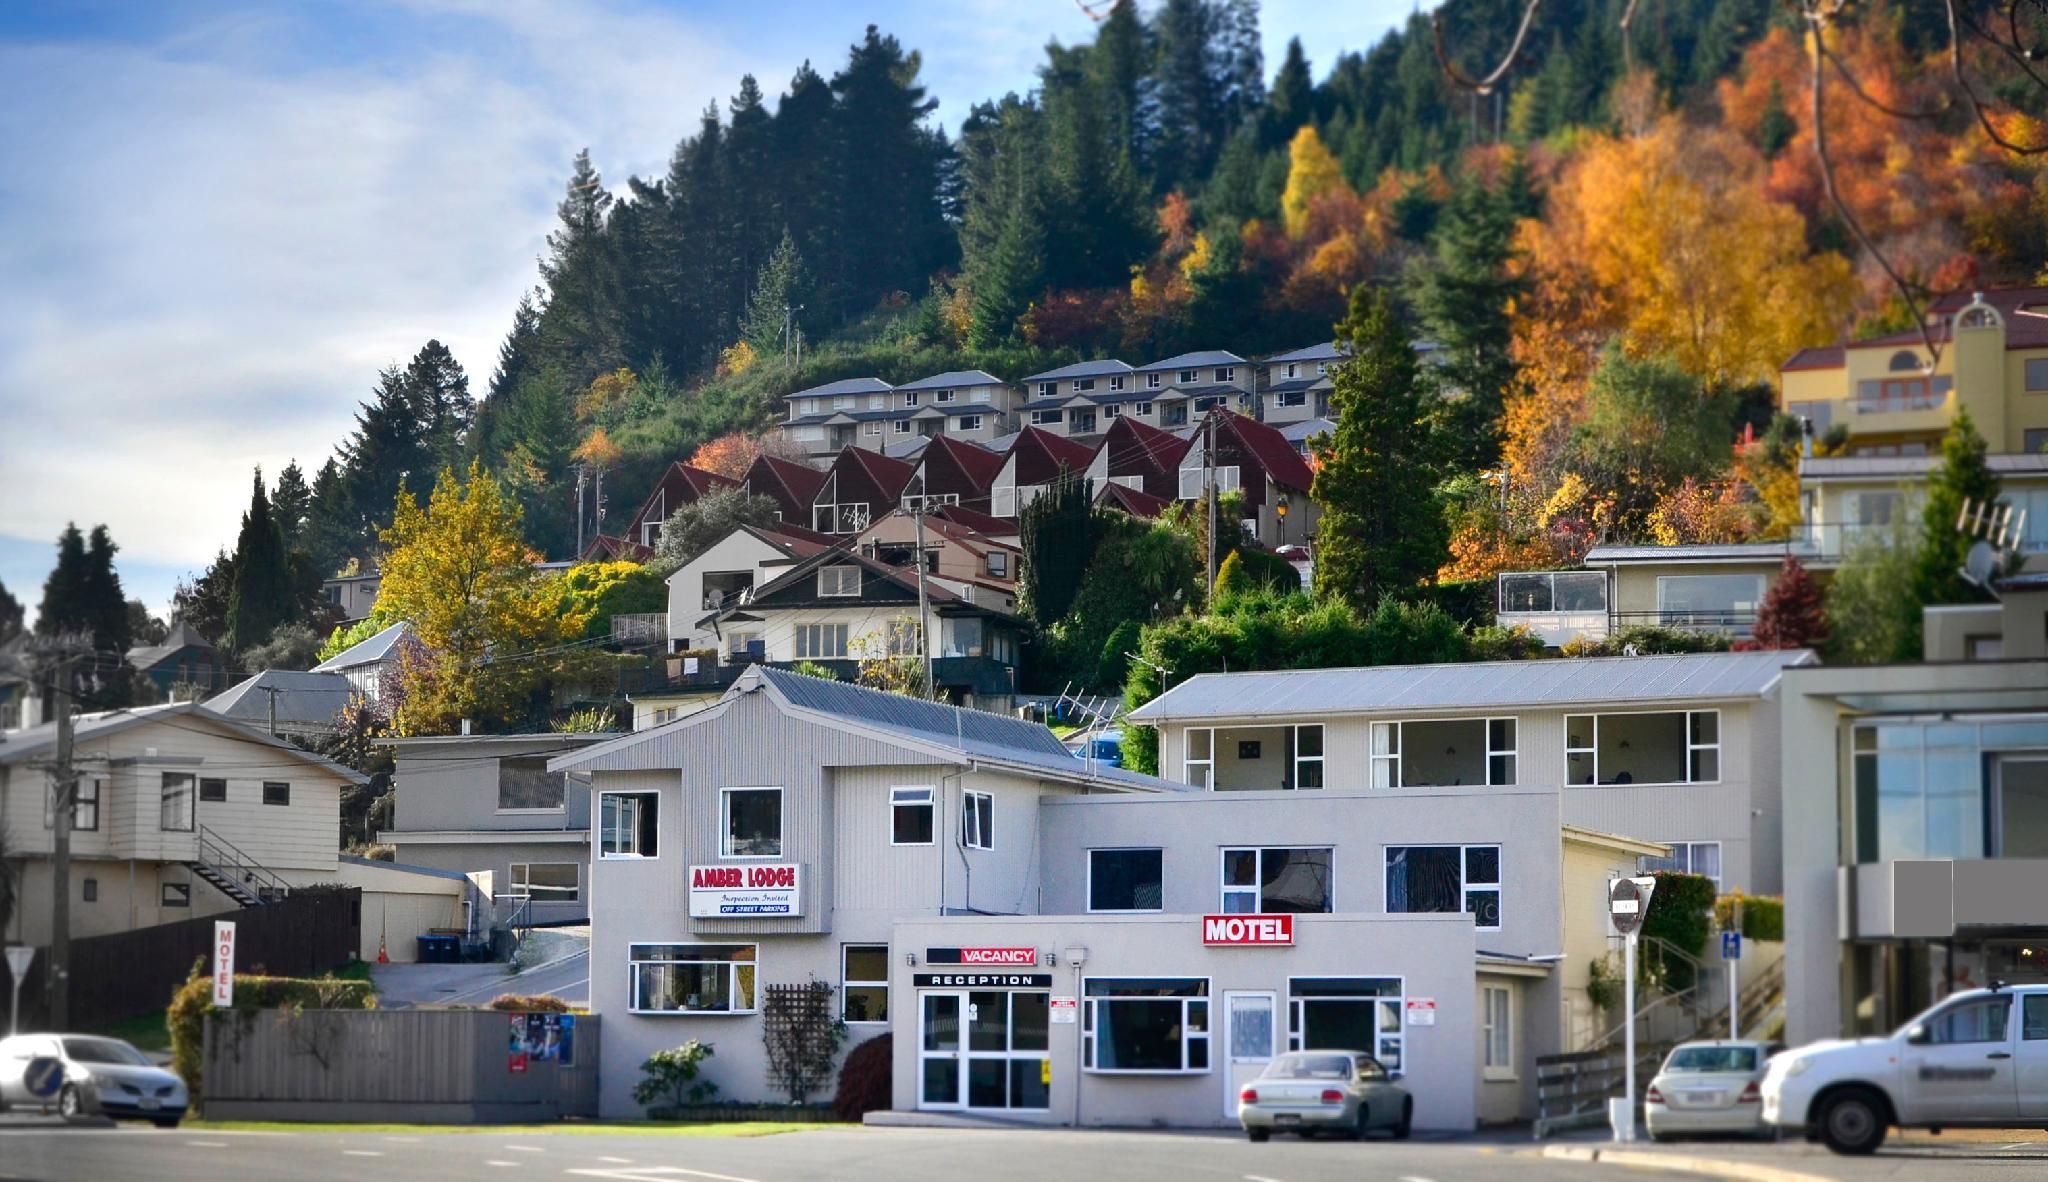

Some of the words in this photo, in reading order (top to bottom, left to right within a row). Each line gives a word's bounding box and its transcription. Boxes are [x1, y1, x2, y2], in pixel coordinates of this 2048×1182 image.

[693, 868, 743, 888] AMBER
[749, 867, 795, 887] LODGE
[720, 894, 760, 904] Inspection
[761, 893, 789, 902] Invited
[735, 905, 759, 913] STREET
[1206, 918, 1290, 941] MOTEL
[963, 950, 1033, 962] VACANCY
[218, 929, 232, 999] MOTEL
[932, 975, 1033, 985] RECEPTION
